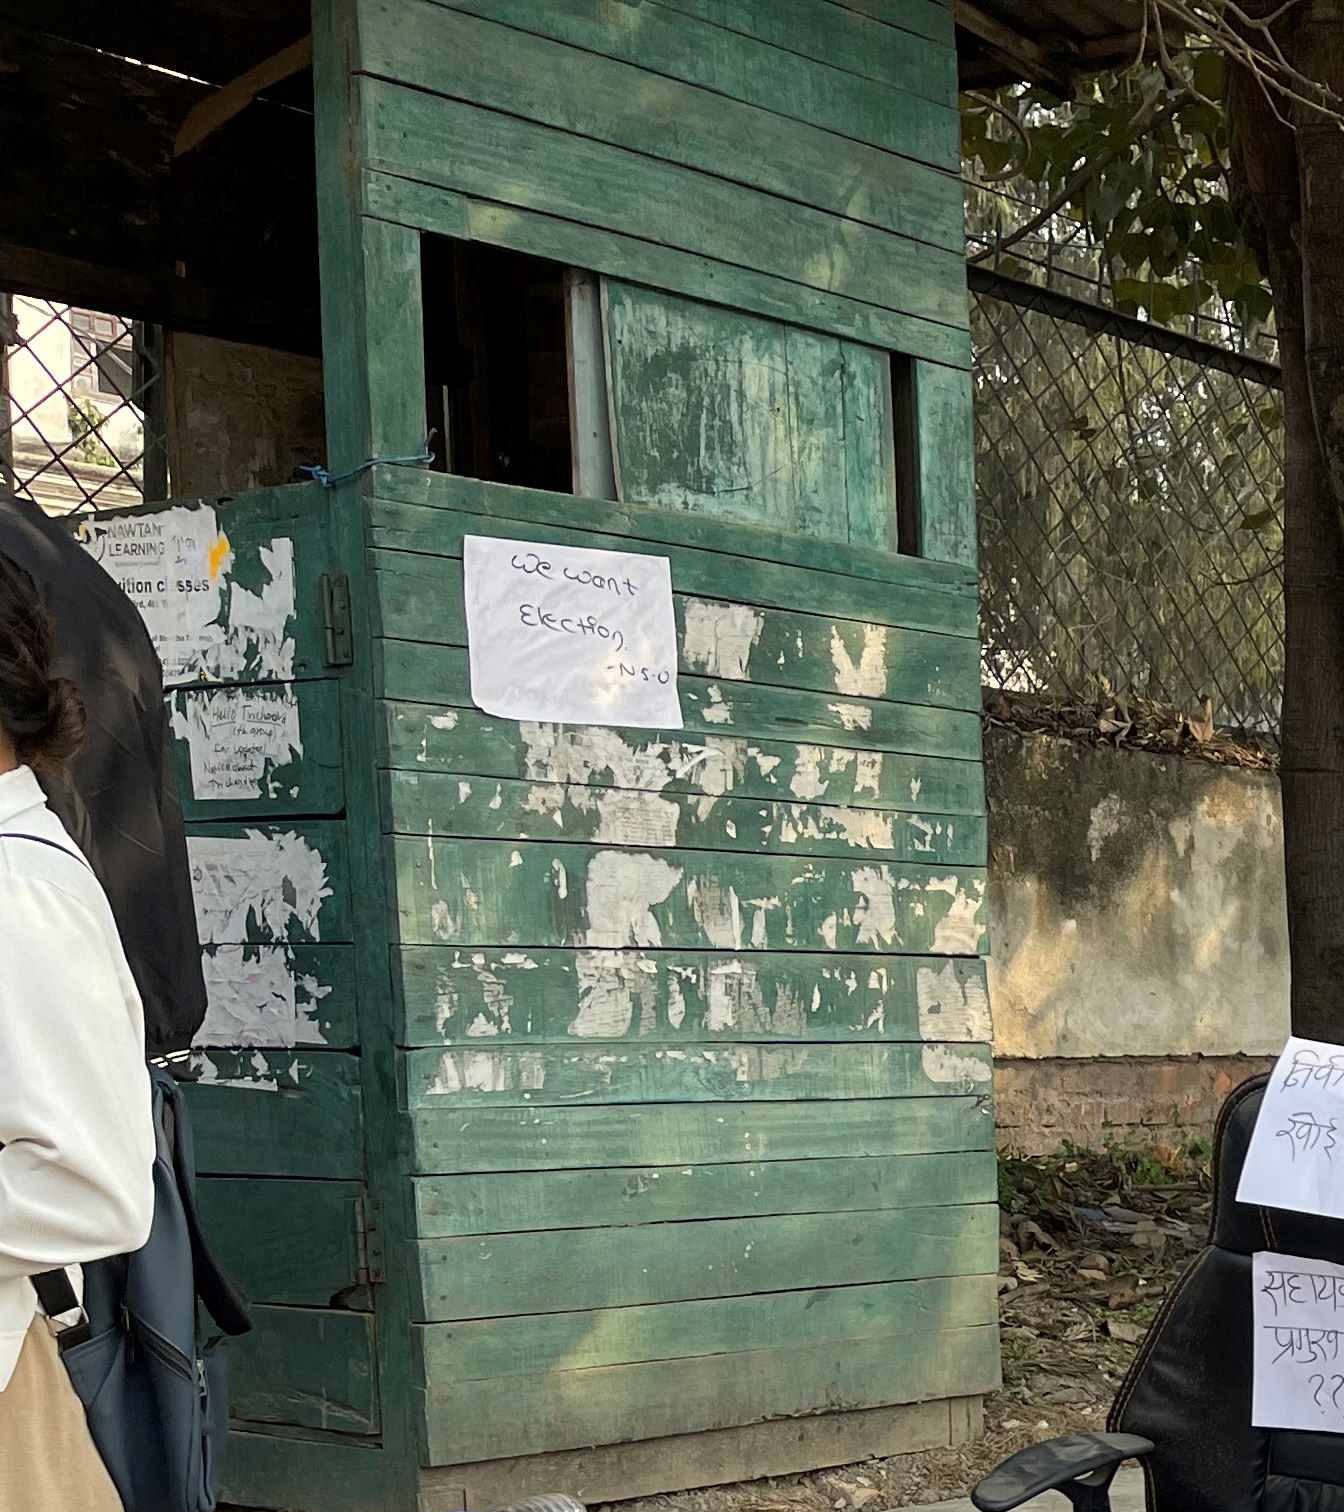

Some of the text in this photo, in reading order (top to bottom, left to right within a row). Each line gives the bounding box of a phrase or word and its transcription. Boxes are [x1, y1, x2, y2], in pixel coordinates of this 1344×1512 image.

[117, 578, 153, 593] uition
[511, 553, 639, 595] We want
